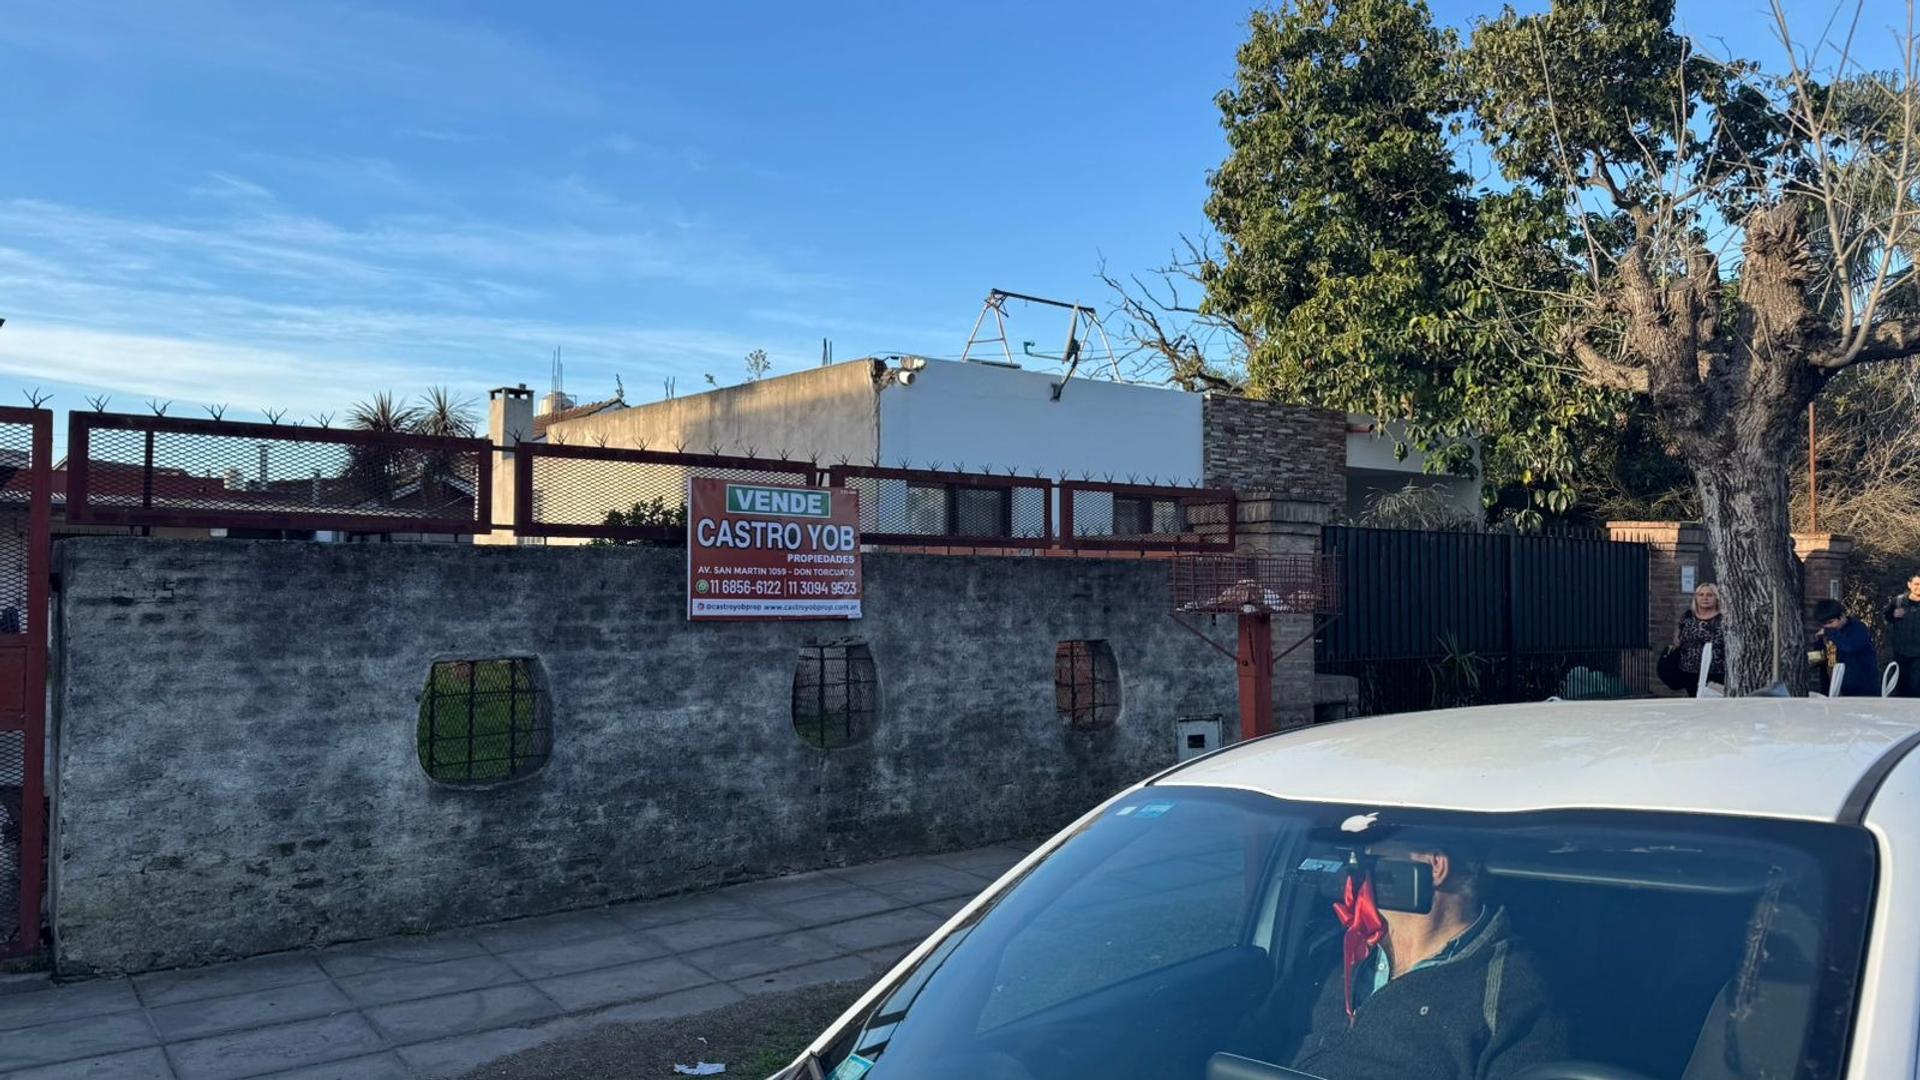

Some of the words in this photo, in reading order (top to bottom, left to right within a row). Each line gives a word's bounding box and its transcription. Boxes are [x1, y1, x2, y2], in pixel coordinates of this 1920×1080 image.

[736, 489, 822, 514] VENDE
[697, 518, 801, 550] CASTRO
[806, 524, 855, 551] YOB
[787, 553, 855, 564] PROPIEDADES
[697, 566, 712, 574] AV.
[713, 566, 732, 575] SAN
[733, 567, 767, 575] MARTIN
[768, 568, 787, 576] 1059
[793, 568, 812, 576] DON
[813, 568, 855, 577] TORCUATO
[710, 579, 719, 594] 11
[722, 580, 782, 595] 6856-6122
[788, 581, 797, 595] 11
[800, 581, 829, 595] 3094
[830, 582, 857, 595] 9523
[706, 603, 762, 612] @castroyobprop
